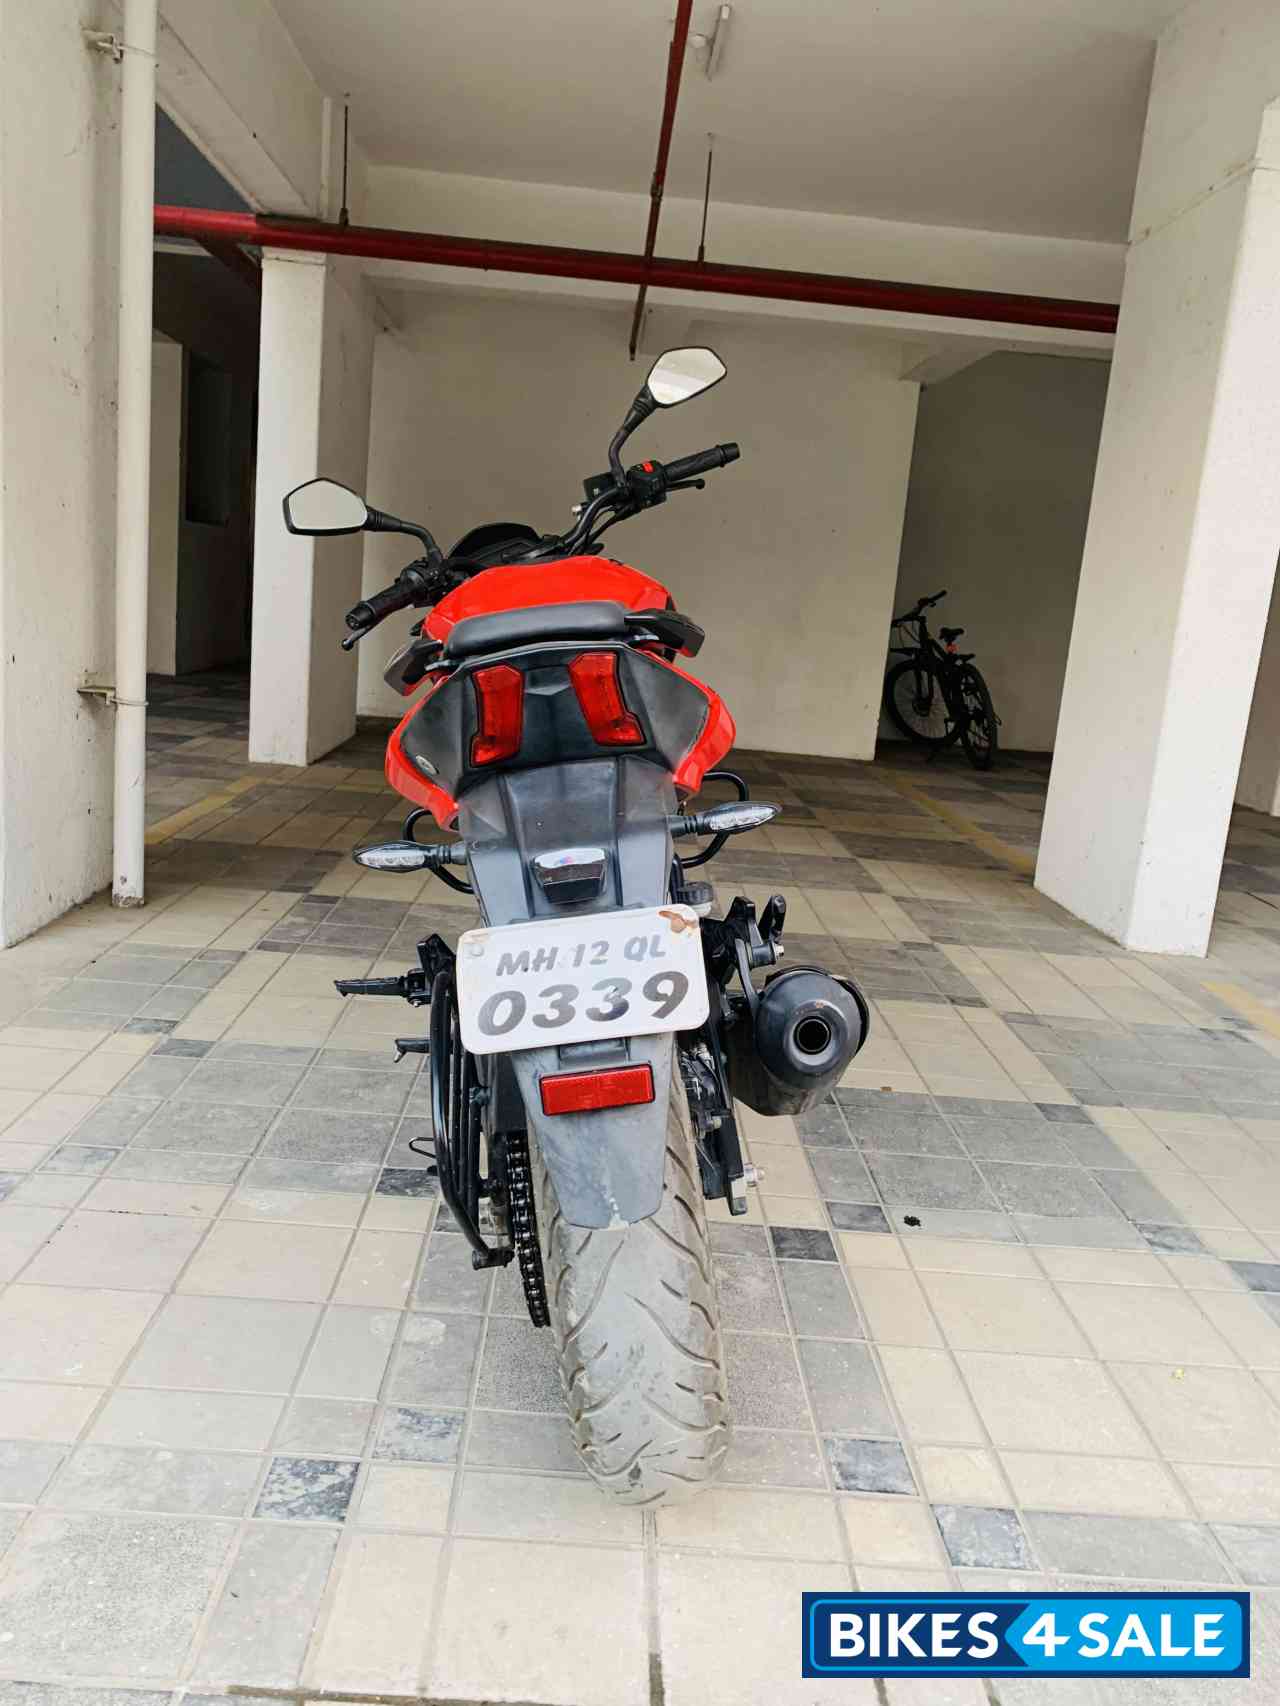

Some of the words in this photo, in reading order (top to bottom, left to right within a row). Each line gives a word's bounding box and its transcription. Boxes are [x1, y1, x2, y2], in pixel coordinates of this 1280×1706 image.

[496, 946, 559, 976] MH
[572, 940, 610, 967] 12
[624, 935, 667, 961] QL
[478, 970, 689, 1036] 0339
